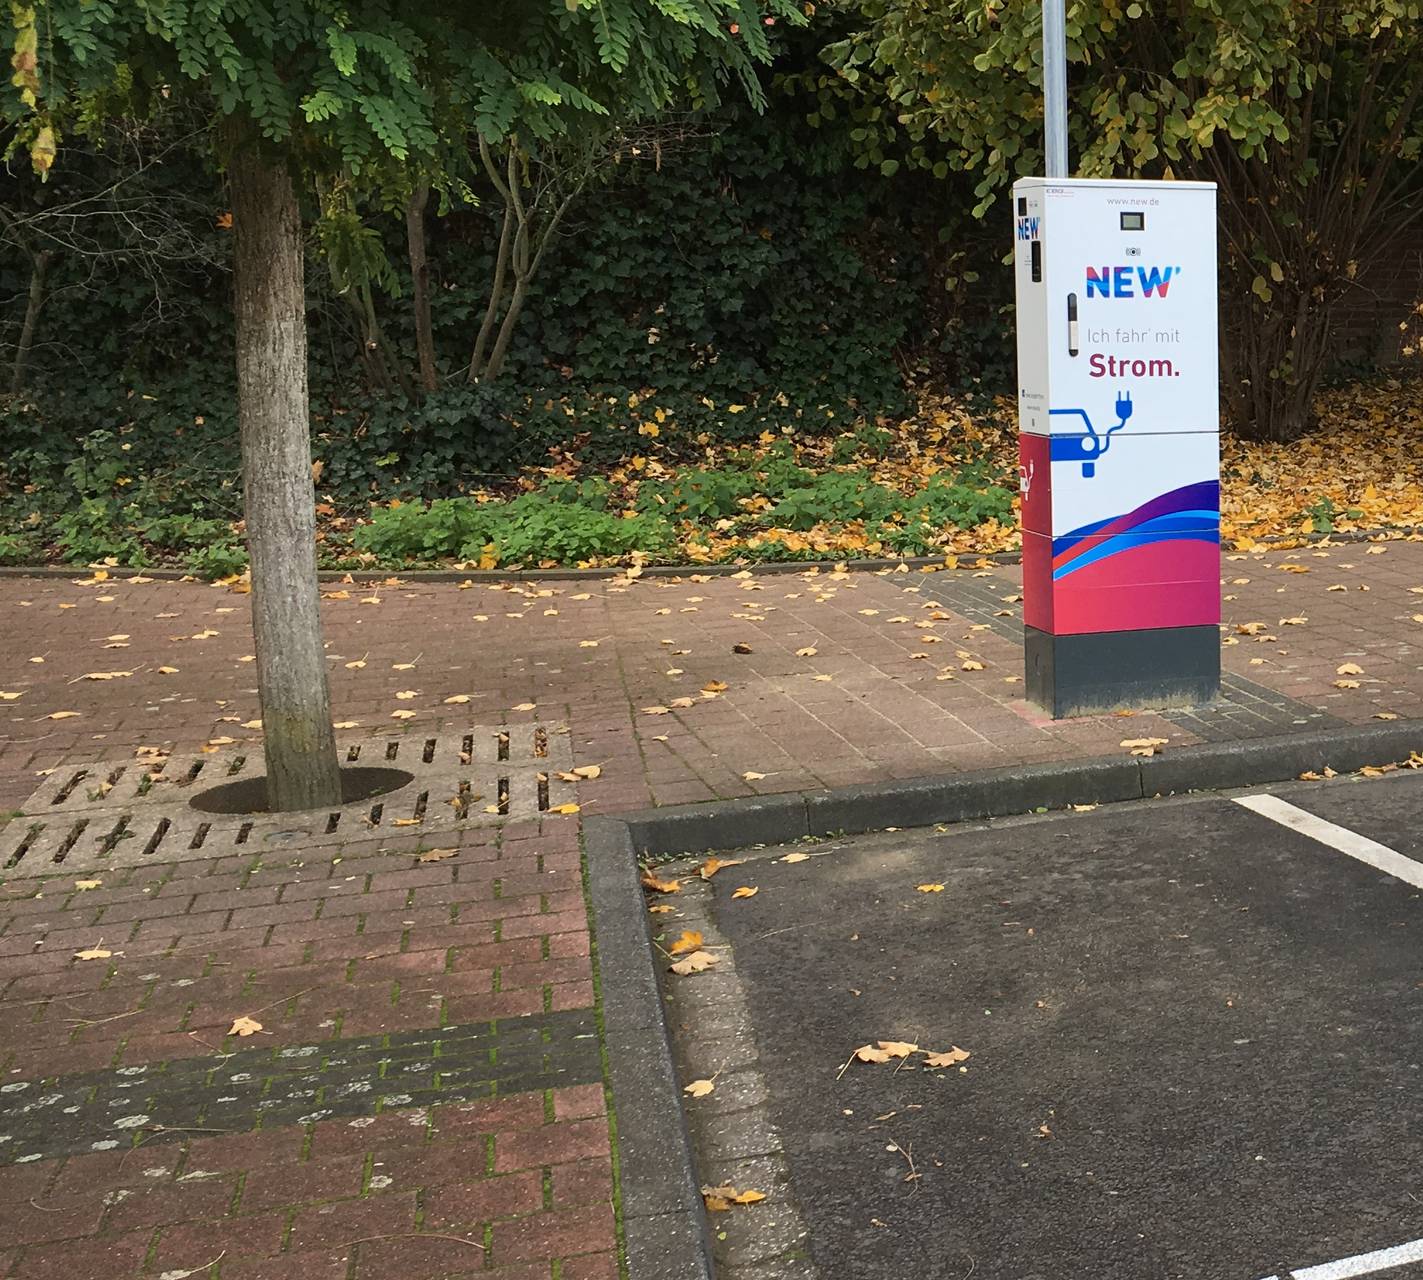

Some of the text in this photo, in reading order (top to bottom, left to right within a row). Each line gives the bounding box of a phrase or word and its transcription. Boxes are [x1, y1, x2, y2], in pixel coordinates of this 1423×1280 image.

[1106, 197, 1160, 206] www.new.de
[1087, 327, 1110, 343] Ich
[1155, 327, 1181, 343] mit
[1089, 352, 1181, 378] Strom.
